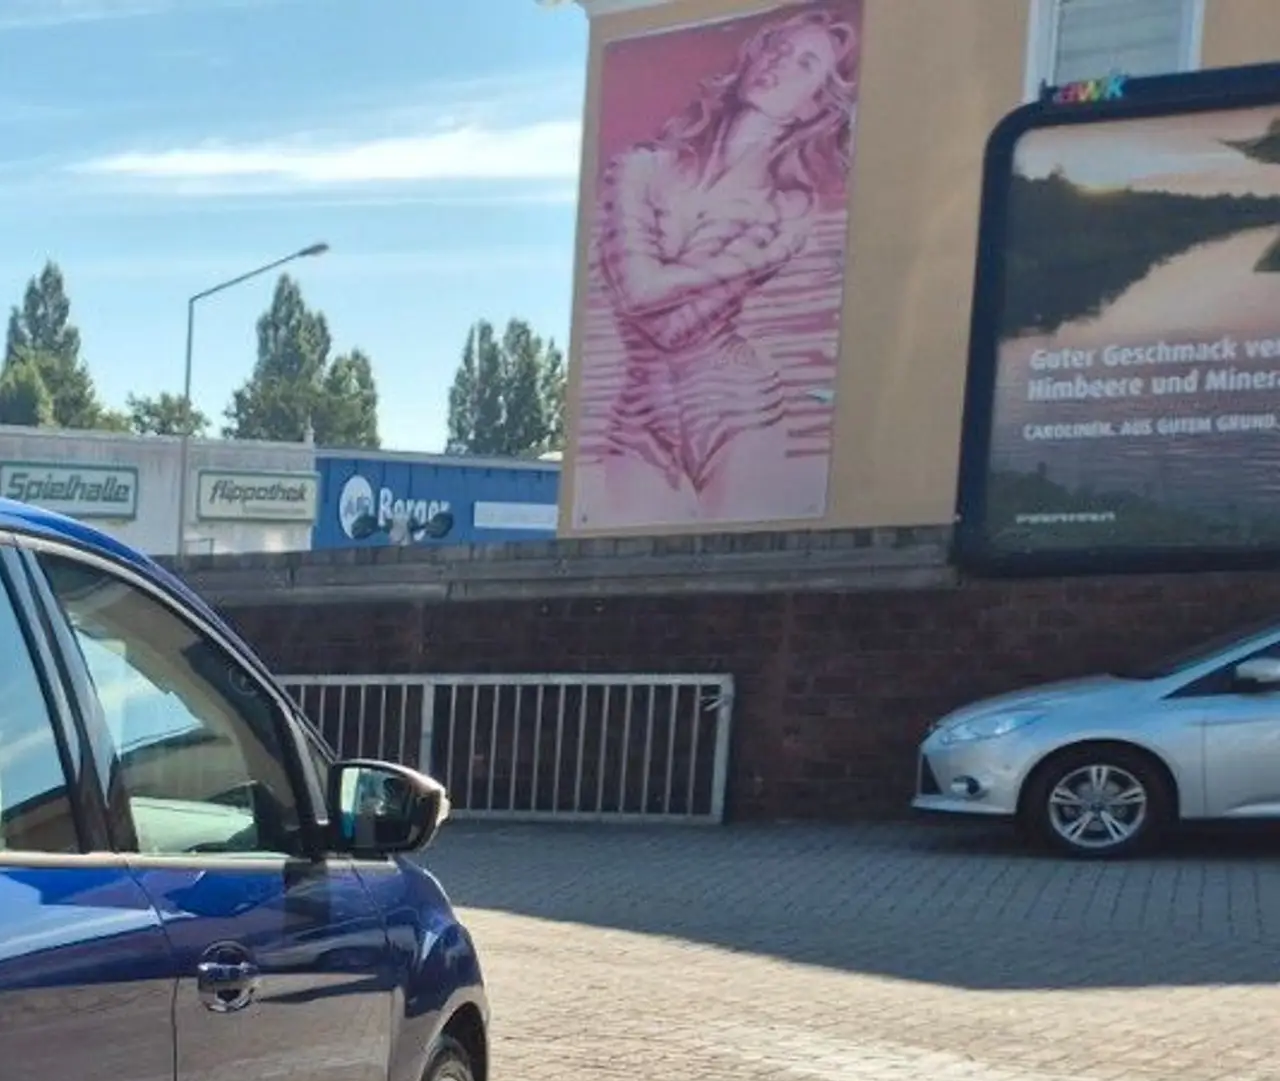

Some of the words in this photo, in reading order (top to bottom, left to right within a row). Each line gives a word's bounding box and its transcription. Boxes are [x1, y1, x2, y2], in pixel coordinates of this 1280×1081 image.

[1029, 347, 1094, 371] Guter
[1102, 335, 1238, 367] Geschmack
[1027, 372, 1144, 400] Himbeere
[1151, 369, 1199, 395] und
[1204, 365, 1280, 391] Miner
[1156, 416, 1212, 434] GUTEM
[6, 472, 131, 503] Spielhalle
